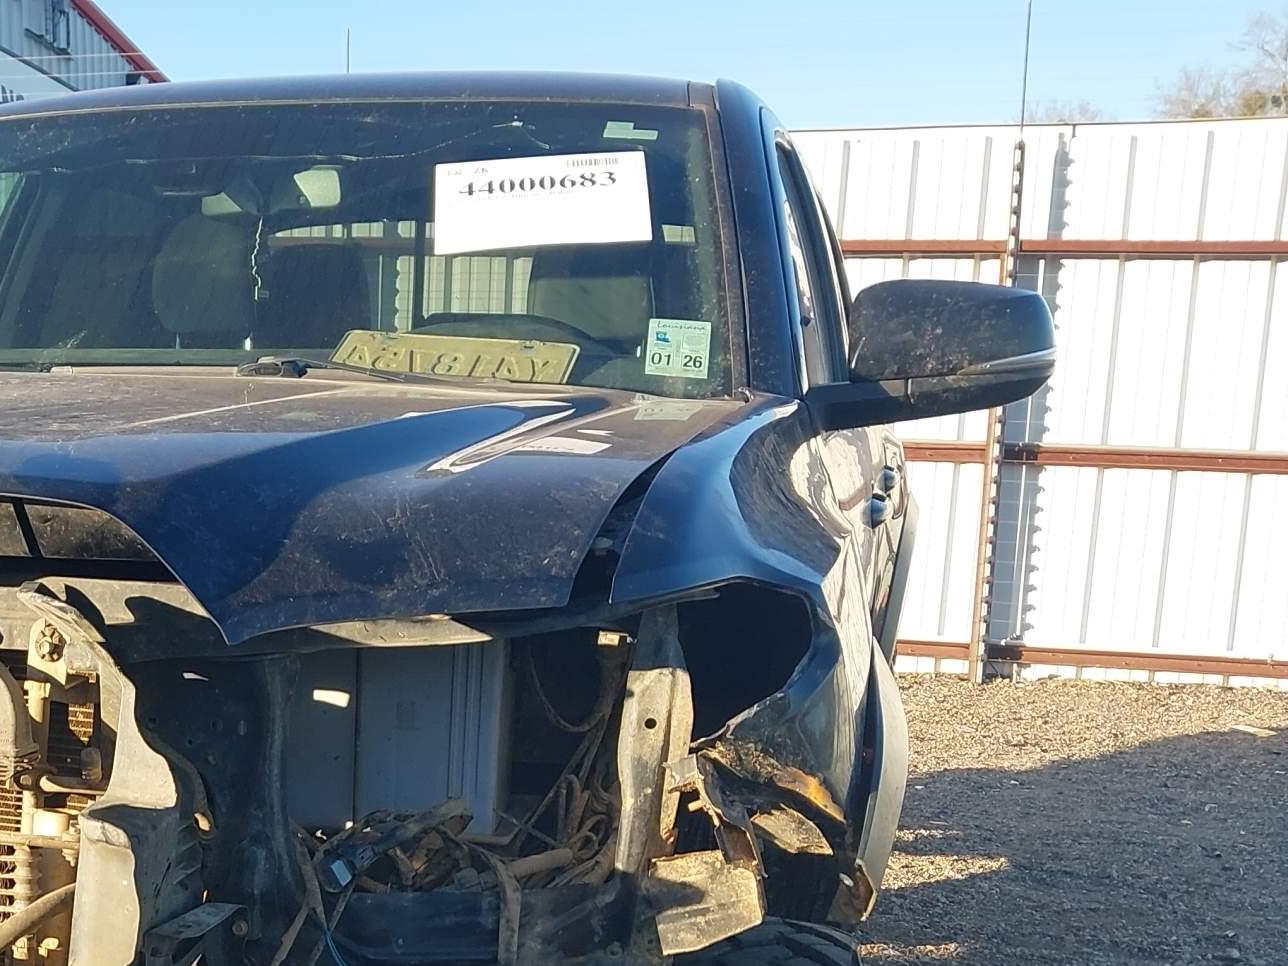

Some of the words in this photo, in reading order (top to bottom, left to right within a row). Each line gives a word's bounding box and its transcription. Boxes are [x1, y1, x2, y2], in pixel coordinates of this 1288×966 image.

[458, 170, 617, 197] 44000683
[651, 352, 672, 366] 01
[682, 354, 703, 369] 26
